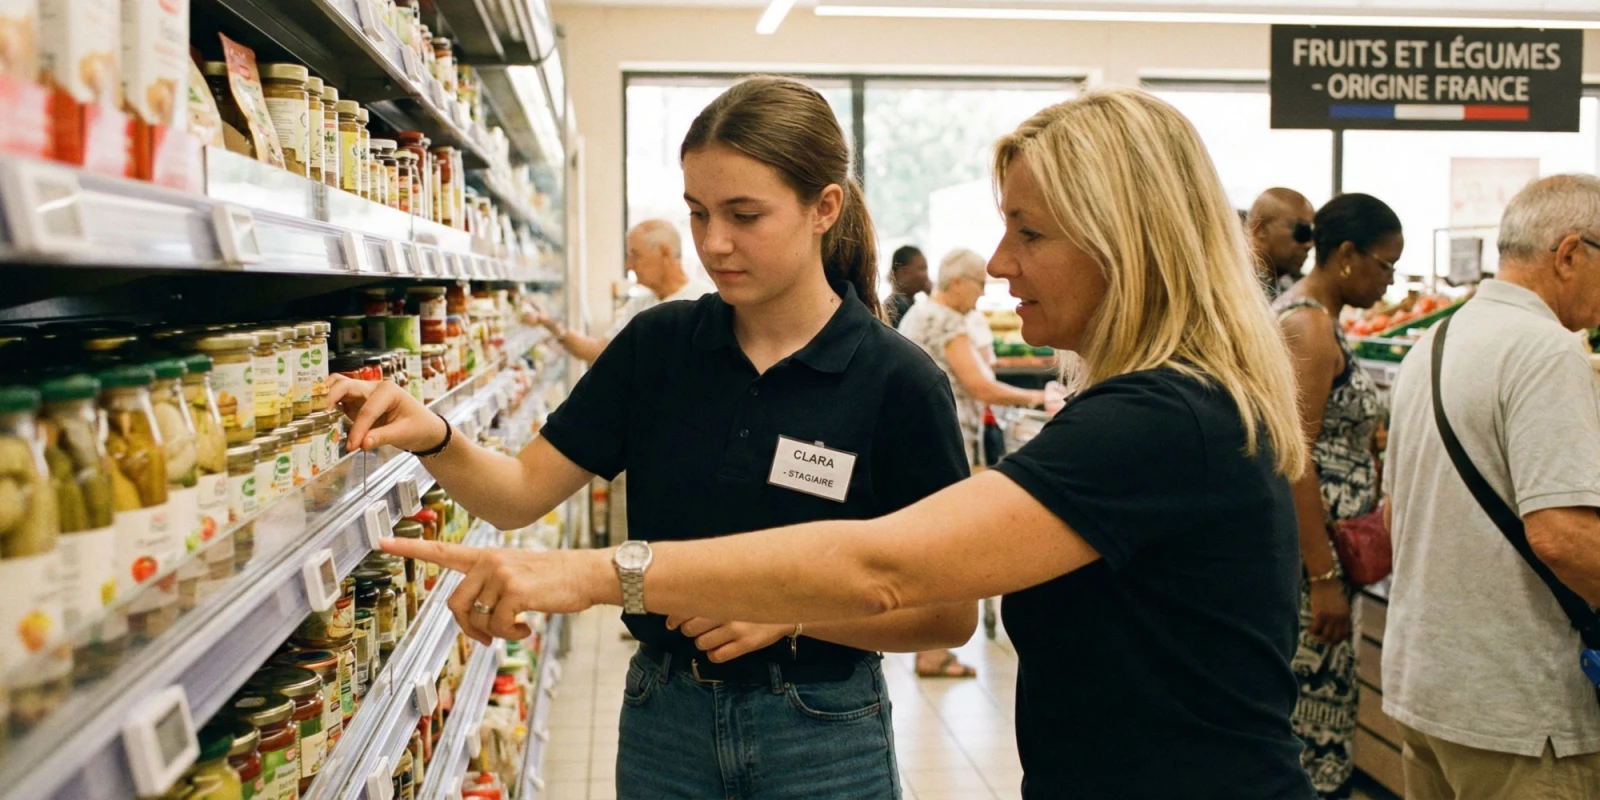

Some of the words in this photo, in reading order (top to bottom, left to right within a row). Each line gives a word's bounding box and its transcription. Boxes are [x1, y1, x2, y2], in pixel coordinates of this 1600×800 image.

[1293, 39, 1388, 68] FRUITS
[1395, 40, 1429, 69] ET
[1435, 35, 1561, 70] LÉGUMES
[1328, 73, 1429, 101] ORIGINE
[1435, 75, 1530, 102] FRANCE
[793, 450, 834, 468] CLARA
[788, 470, 834, 488] STAGIAIRE
